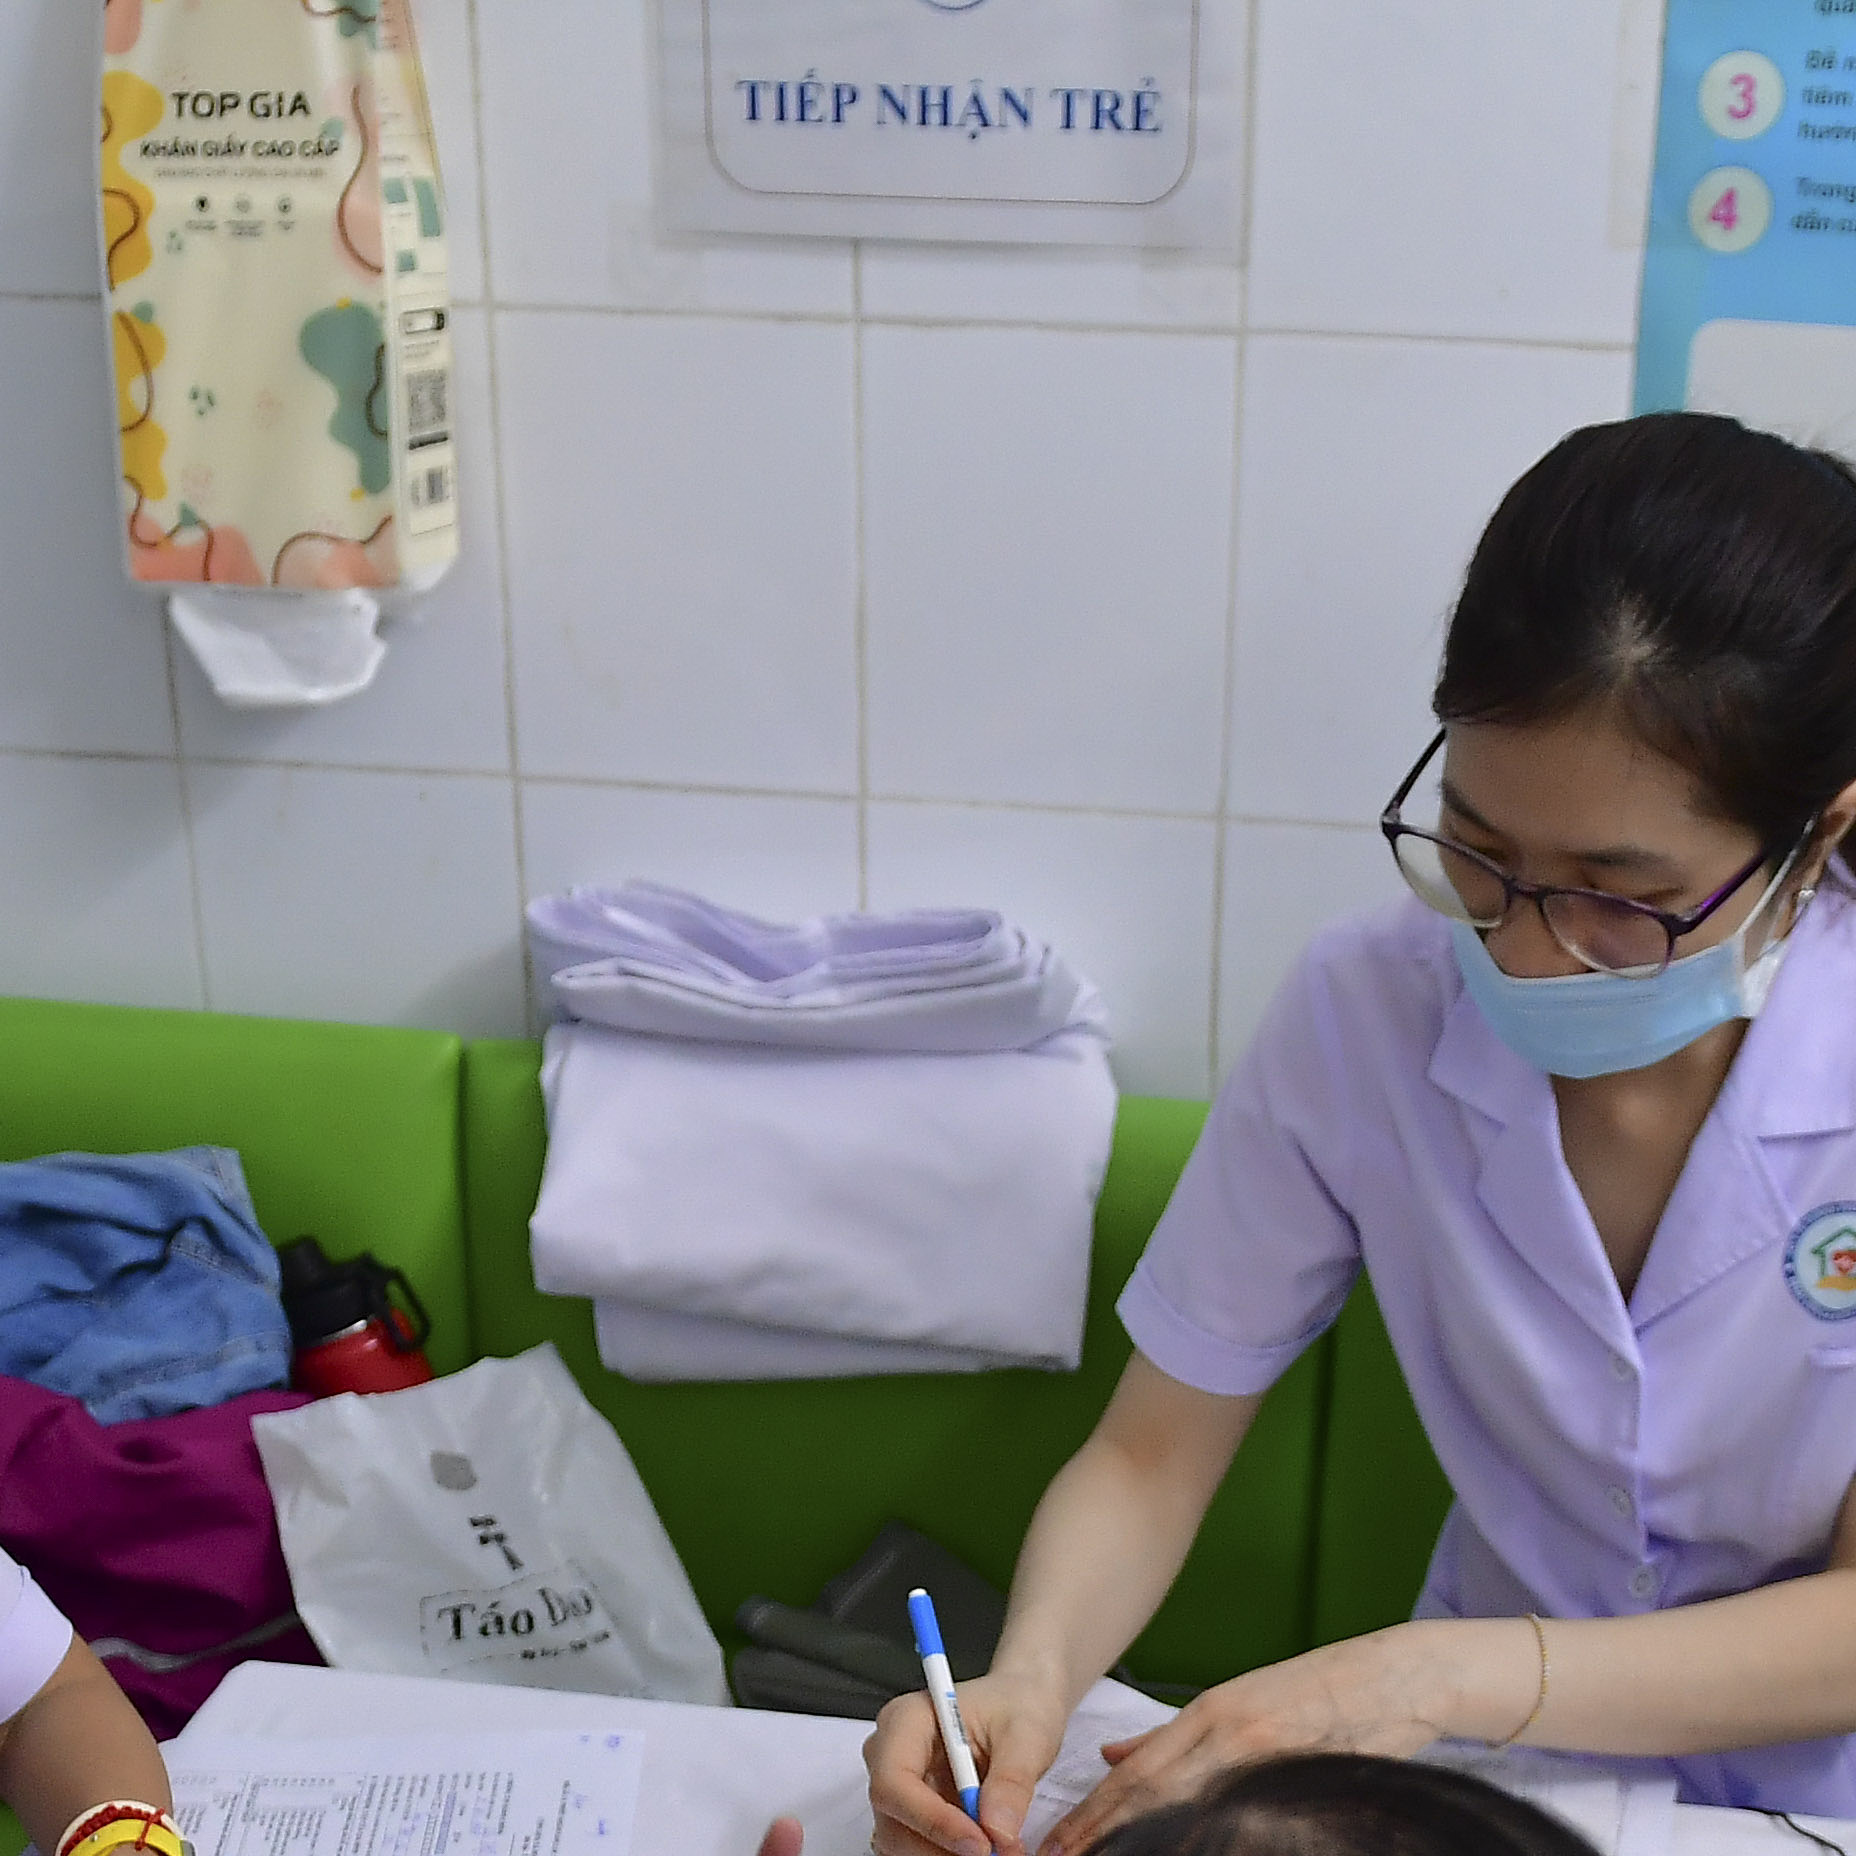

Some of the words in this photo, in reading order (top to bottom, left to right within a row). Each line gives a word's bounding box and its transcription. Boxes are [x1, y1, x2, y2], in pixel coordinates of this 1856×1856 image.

[171, 91, 242, 119] TOP
[248, 91, 312, 118] GIA
[737, 67, 860, 123] TIẾP
[876, 79, 1034, 140] NHẬN
[1051, 75, 1163, 133] TRẺ
[1728, 74, 1756, 120] 3
[1709, 188, 1739, 232] 4
[438, 1600, 535, 1640] Táo
